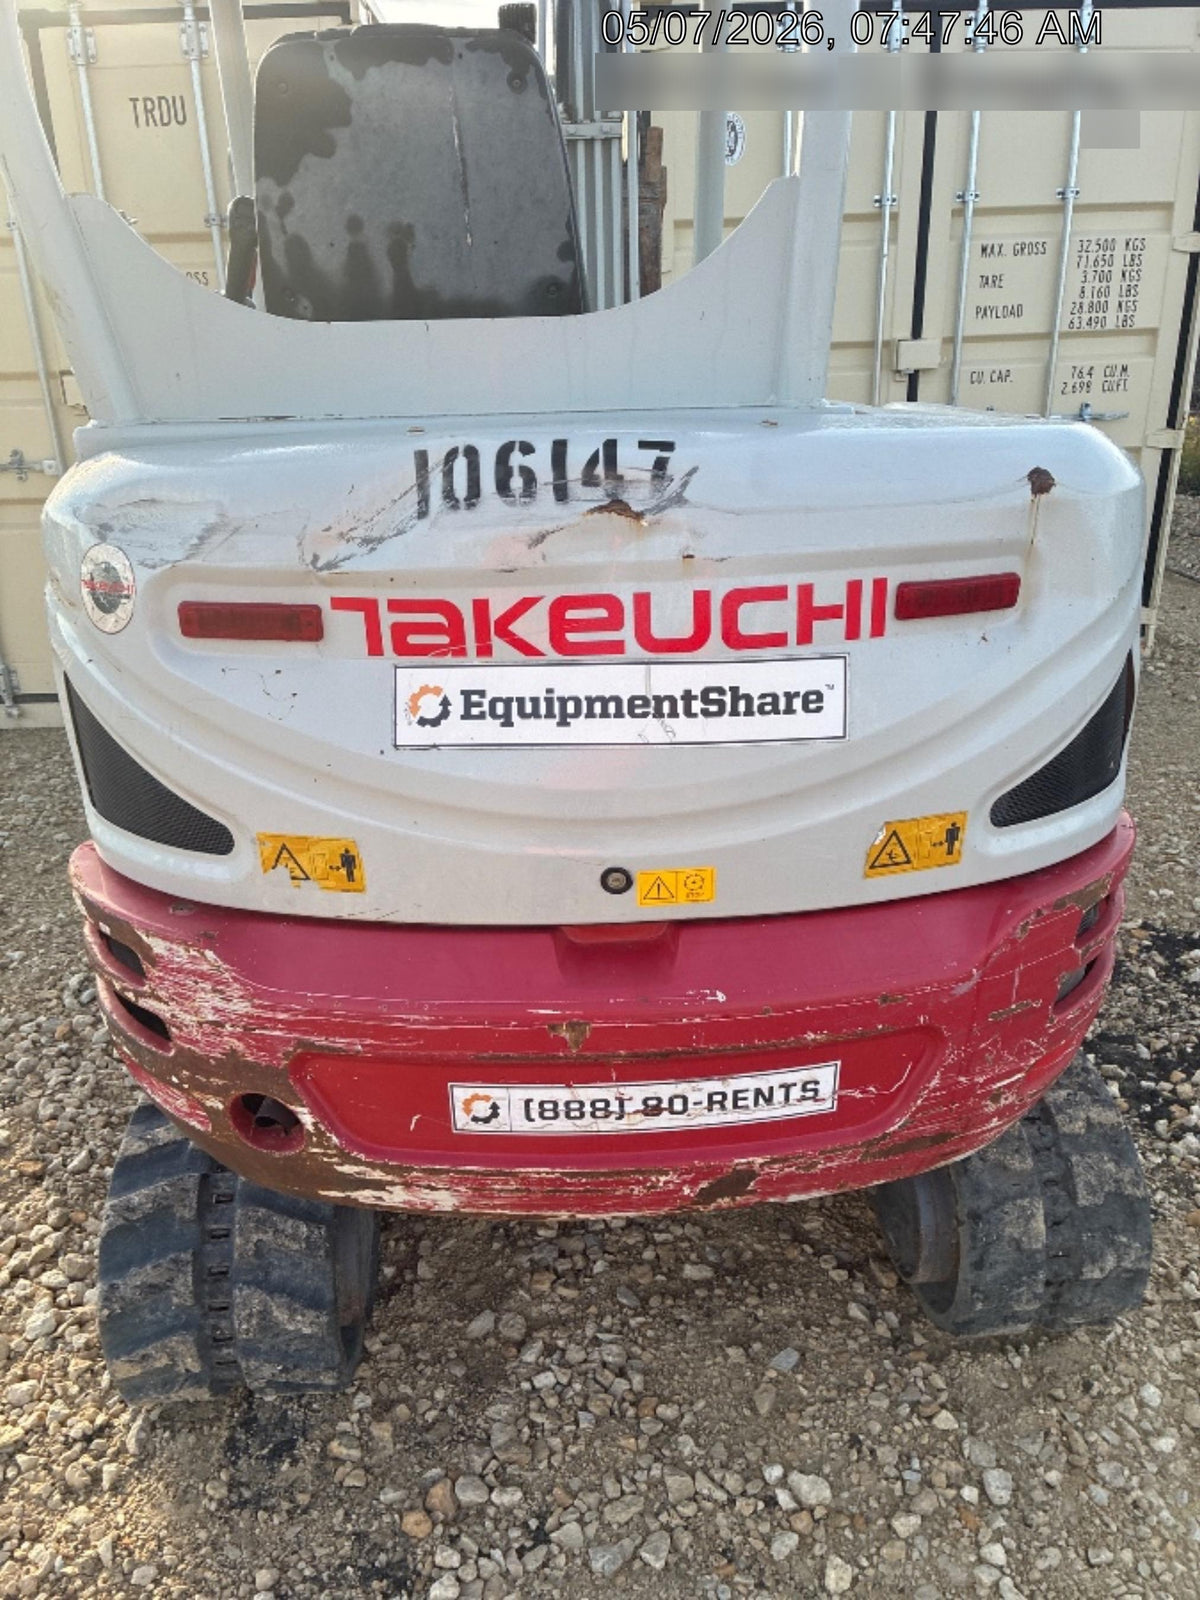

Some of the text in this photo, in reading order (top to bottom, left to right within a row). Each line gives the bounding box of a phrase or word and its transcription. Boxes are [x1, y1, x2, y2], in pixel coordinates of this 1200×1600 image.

[128, 95, 188, 128] TRDU
[980, 237, 1147, 258] MAX. GROSS 32.500 KGS
[1076, 253, 1143, 269] 71.650 LBS
[978, 268, 1143, 289] TARE 3.700 KGS
[1118, 283, 1140, 299] LBS
[975, 303, 1024, 320] PAYLOAD
[1116, 300, 1139, 314] KGS
[1067, 314, 1136, 330] 63.490 LBS
[413, 438, 677, 520] 106147
[460, 685, 824, 728] EquipmentShare
[522, 1079, 822, 1123] (888) 80-RENTS
